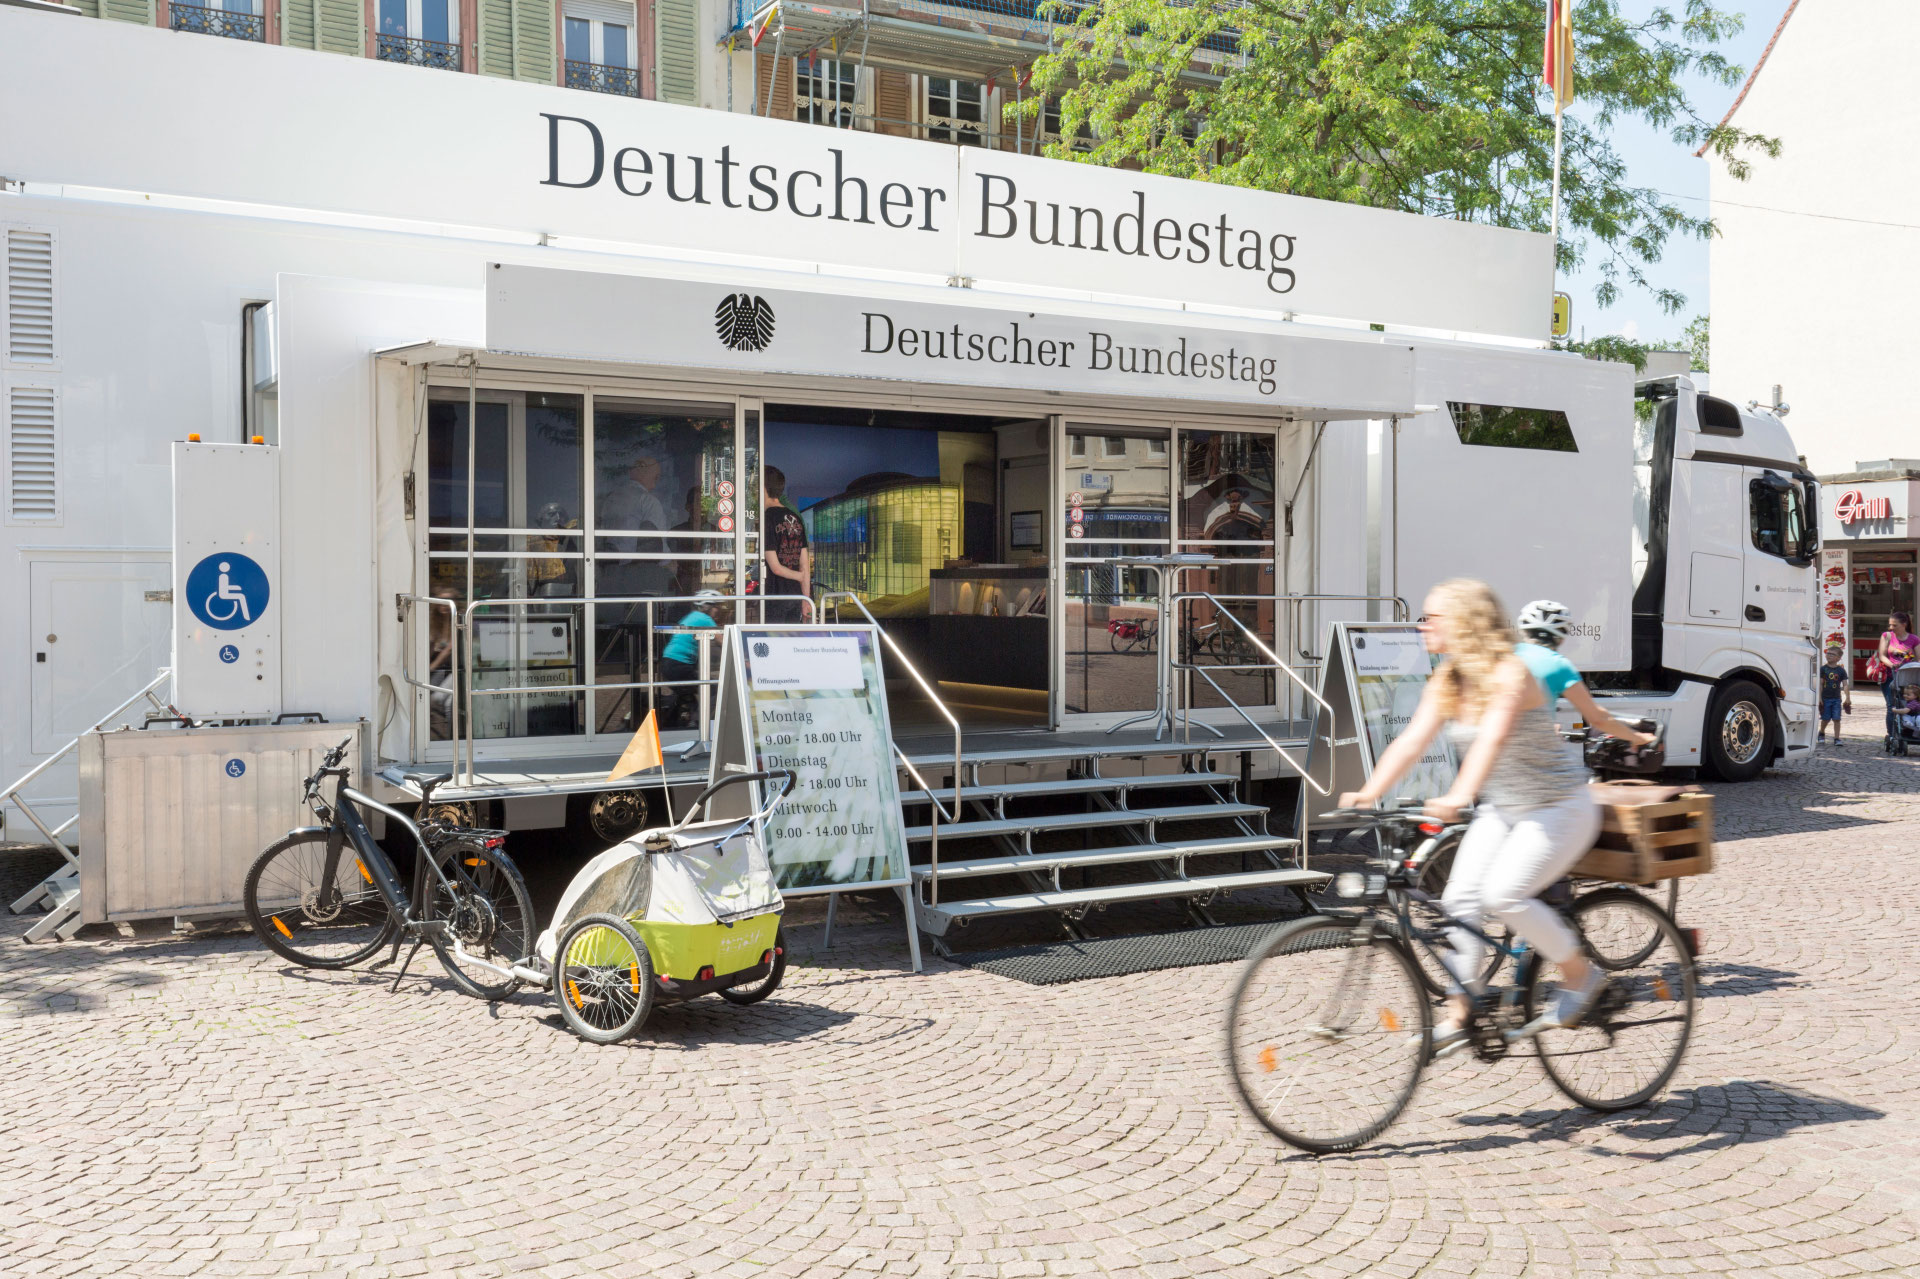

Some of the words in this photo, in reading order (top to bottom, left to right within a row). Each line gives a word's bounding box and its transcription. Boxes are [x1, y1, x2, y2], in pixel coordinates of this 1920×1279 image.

[540, 112, 947, 231] Deutscher
[974, 173, 1295, 293] Bundestag
[861, 312, 1074, 368] Deutscher
[1088, 332, 1277, 395] Bundestag
[1834, 490, 1888, 525] Grill
[1569, 622, 1601, 641] estag
[757, 677, 800, 685] Öffnungszeiten
[762, 710, 814, 724] Montag
[765, 734, 791, 745] 9.00
[804, 732, 836, 744] 18.00
[839, 730, 862, 743] Uhr
[768, 755, 828, 769] Dienstag
[809, 778, 841, 790] 18.00
[845, 775, 868, 788] Uhr
[773, 799, 838, 816] Mittwoch
[776, 827, 802, 839] 9.00
[815, 825, 848, 837] 14.00
[851, 823, 875, 836] Uhr
